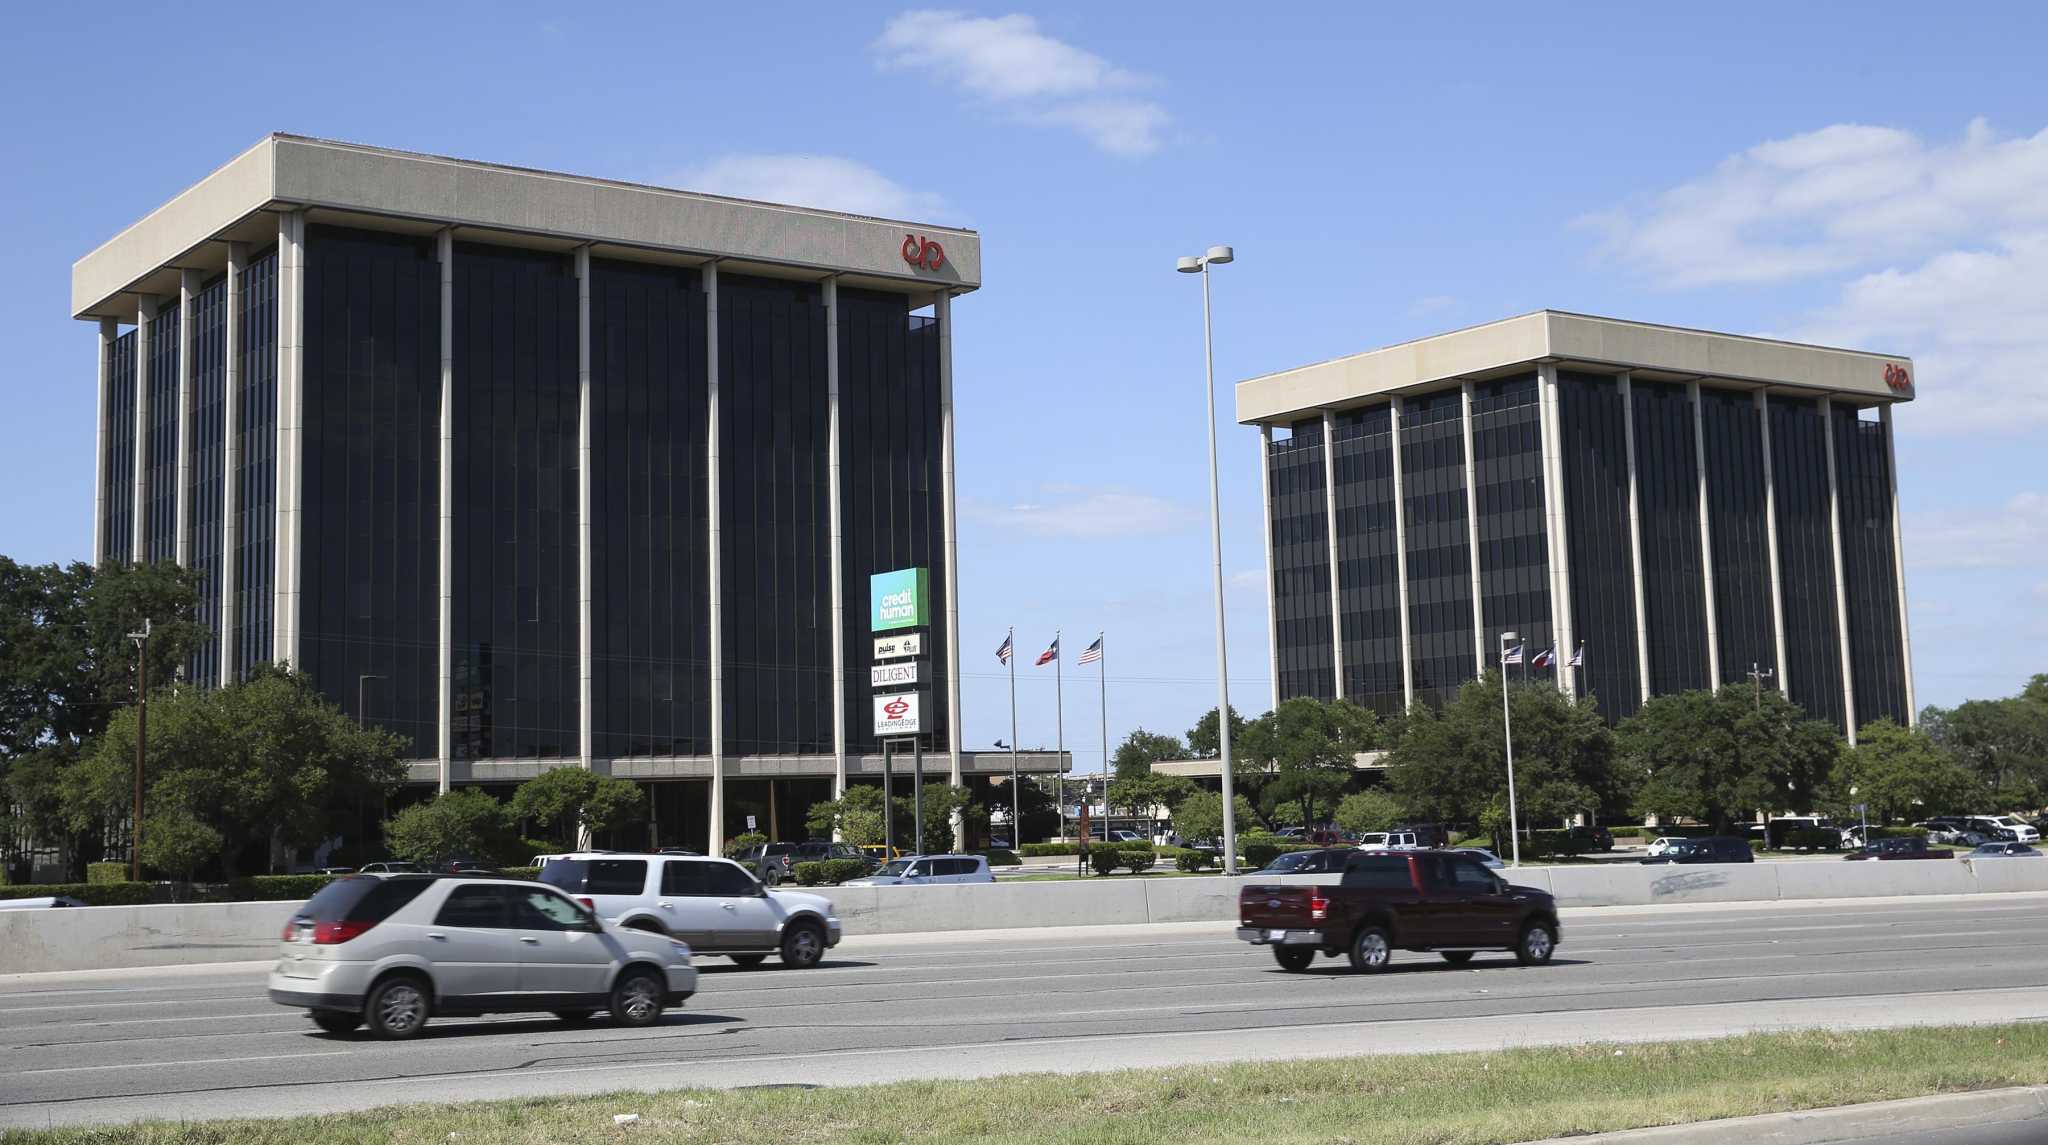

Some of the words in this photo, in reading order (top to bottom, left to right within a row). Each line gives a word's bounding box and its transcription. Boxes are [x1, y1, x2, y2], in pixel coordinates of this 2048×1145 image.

[882, 588, 912, 607] credit
[880, 605, 914, 620] human
[872, 665, 916, 683] DILIGENT
